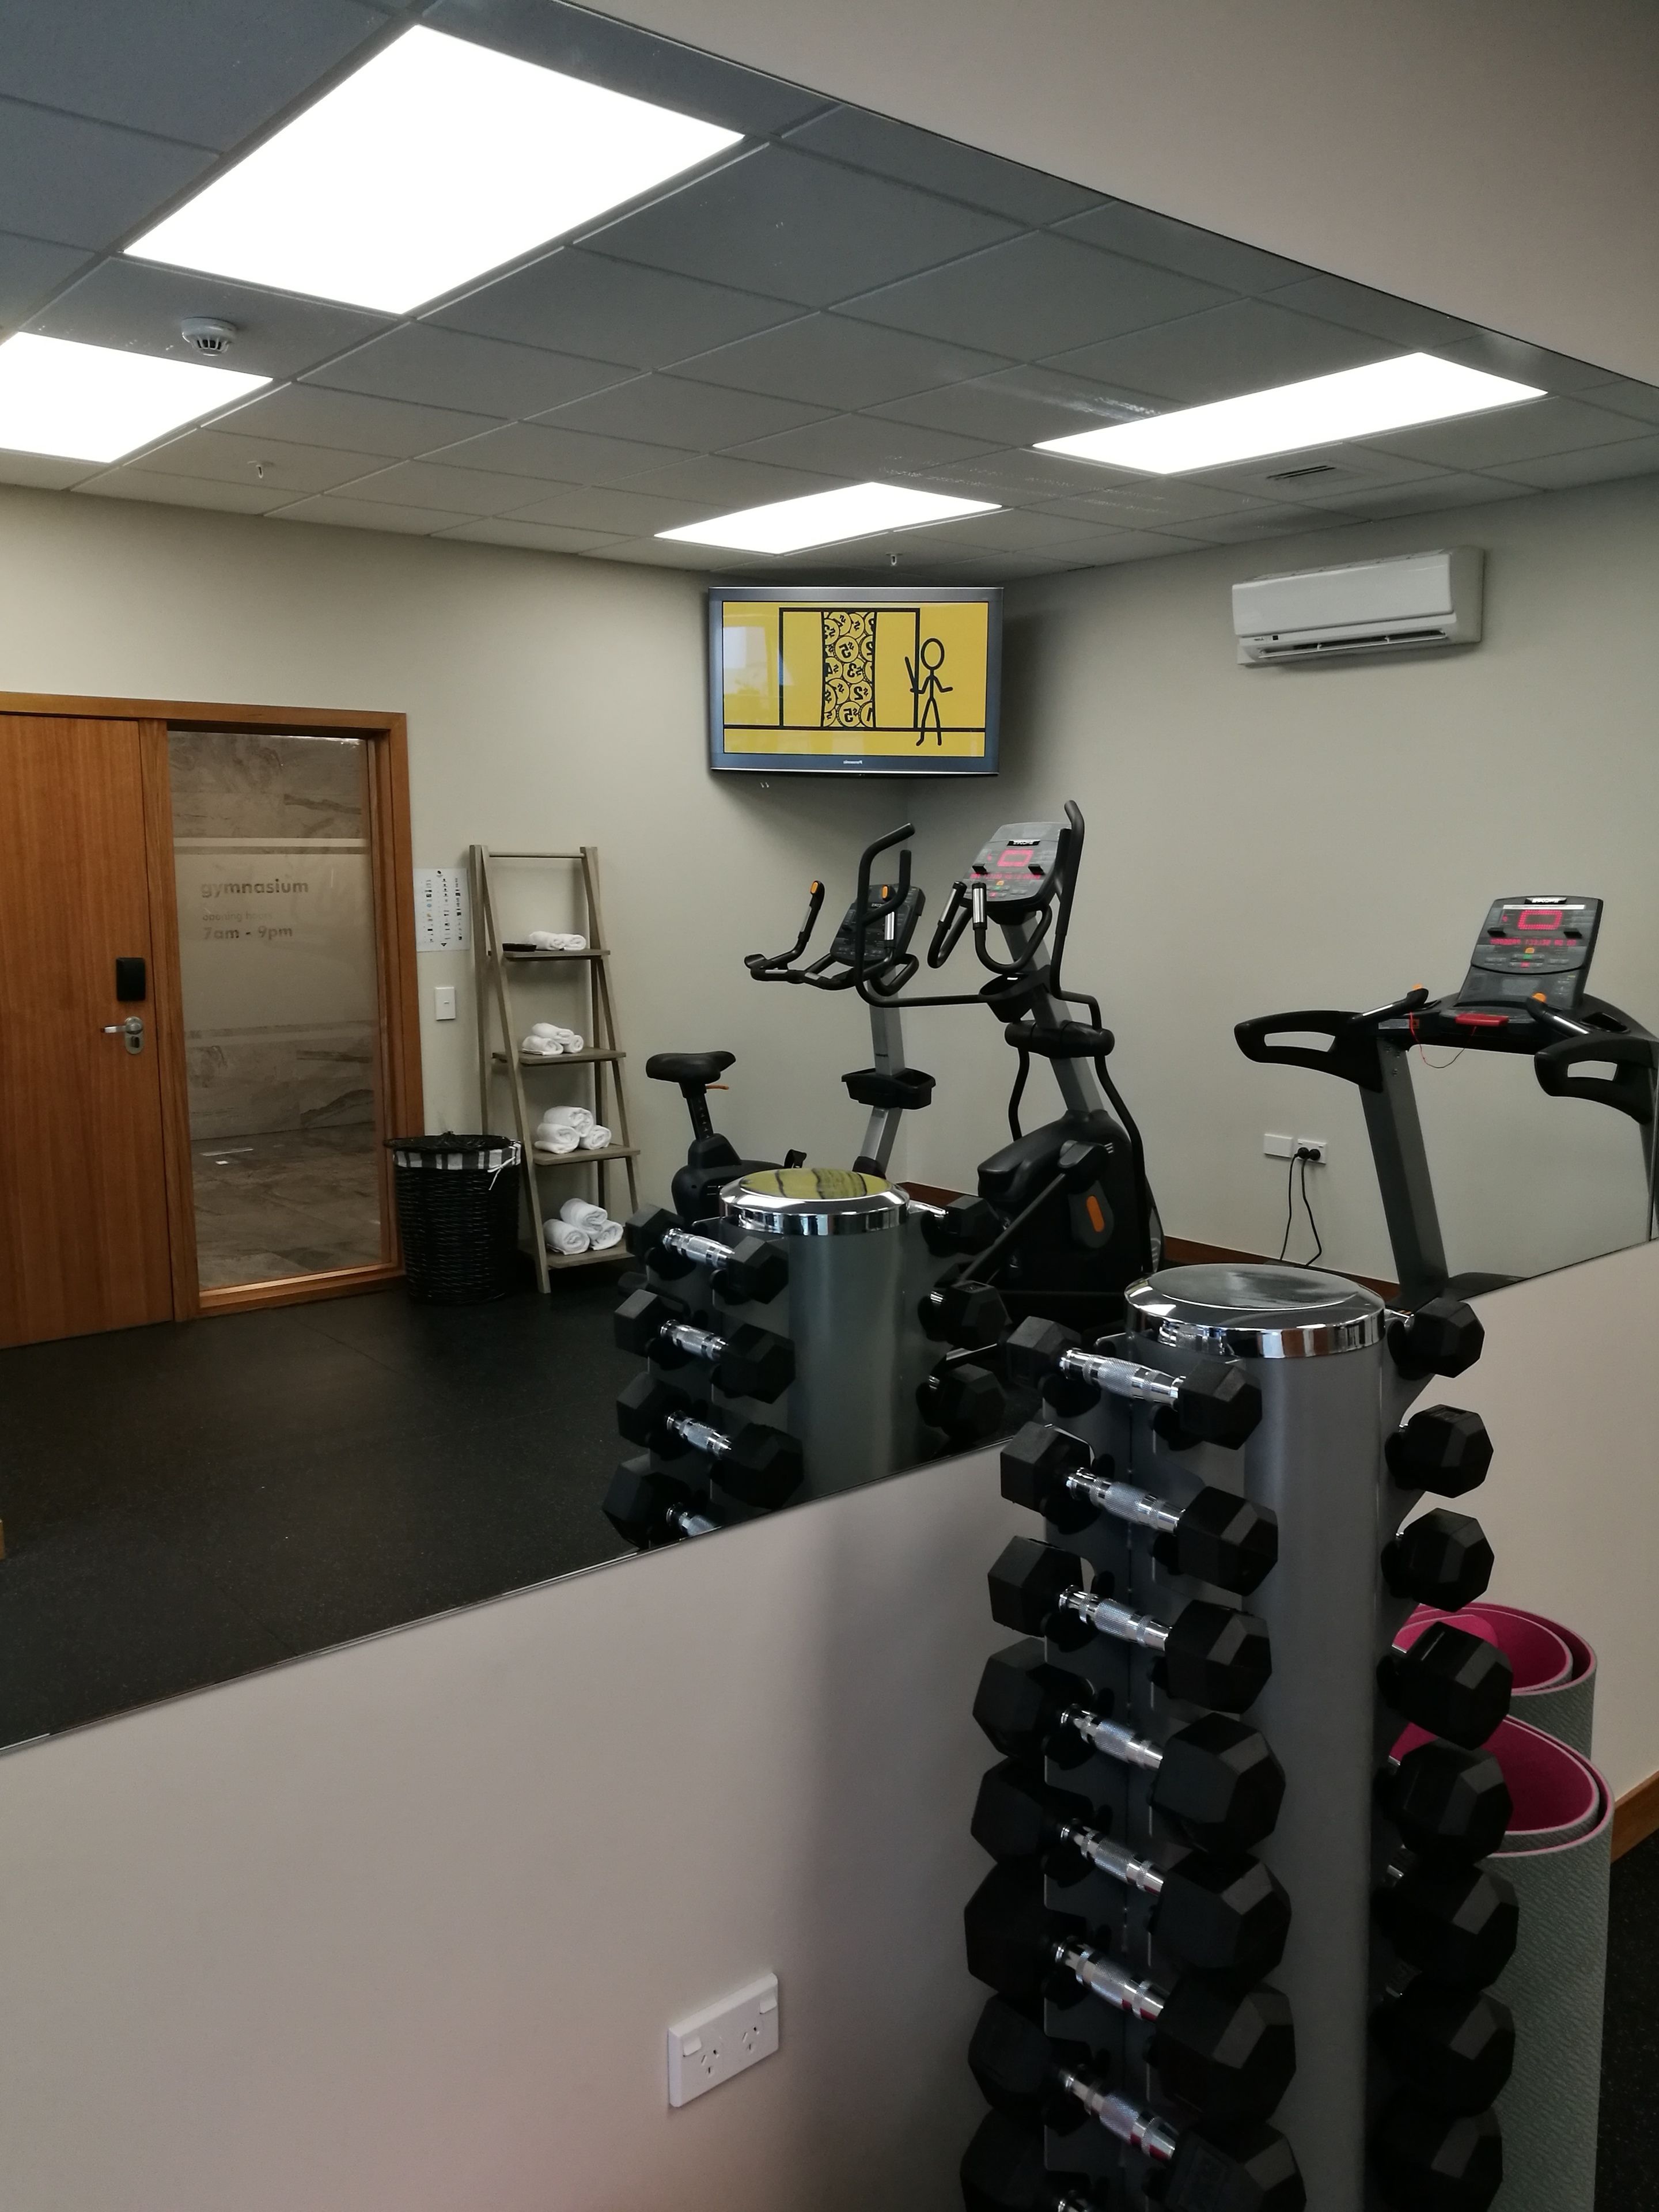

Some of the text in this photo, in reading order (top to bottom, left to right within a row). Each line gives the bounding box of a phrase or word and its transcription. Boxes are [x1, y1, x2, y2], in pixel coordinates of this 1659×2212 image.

[201, 878, 308, 898] gymnasium
[203, 926, 240, 940] 7am
[258, 925, 293, 940] 9pm
